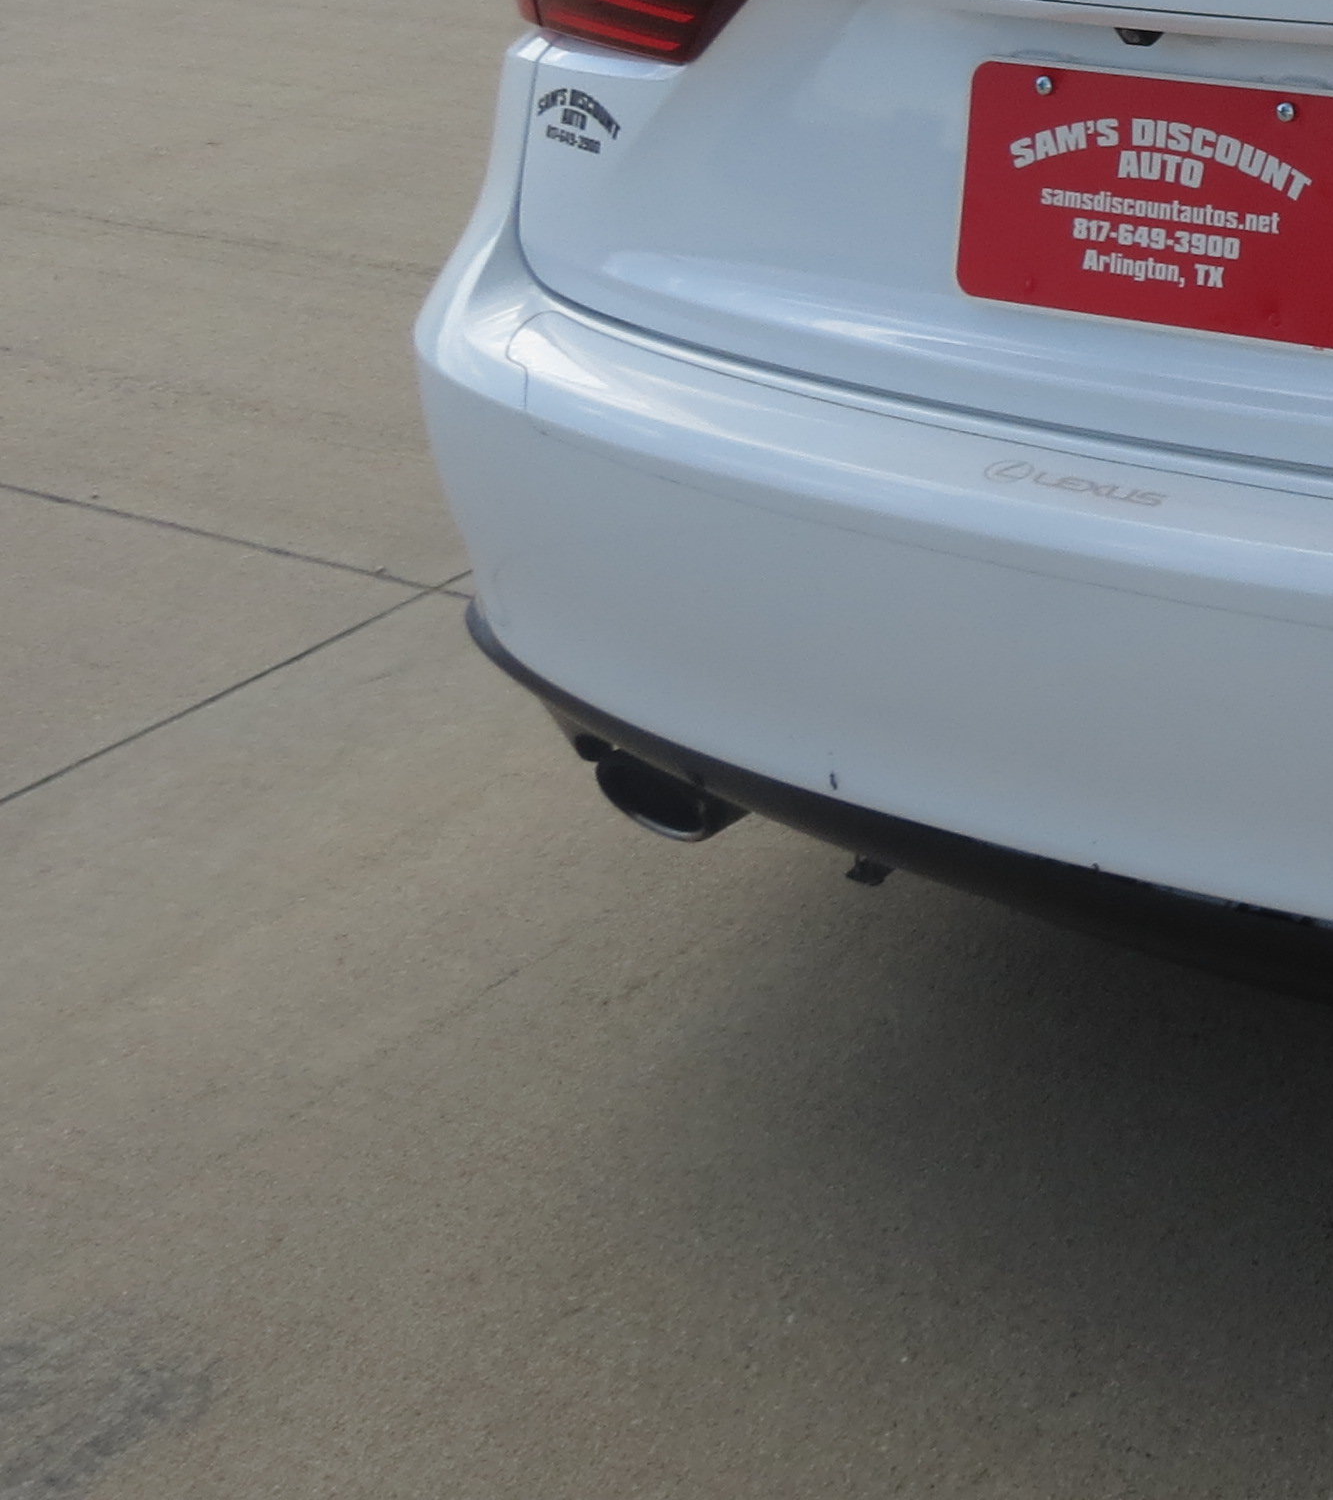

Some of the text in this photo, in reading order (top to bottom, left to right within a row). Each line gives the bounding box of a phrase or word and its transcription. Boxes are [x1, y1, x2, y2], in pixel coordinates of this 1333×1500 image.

[1010, 118, 1312, 202] SAM'S DISCOUNT
[1118, 150, 1204, 188] AUTO
[1040, 187, 1280, 234] samsdiscountautos.net
[1073, 218, 1240, 260] 817-649-3900
[1082, 249, 1225, 288] Arlington, TX
[1032, 472, 1169, 507] LEXUS
